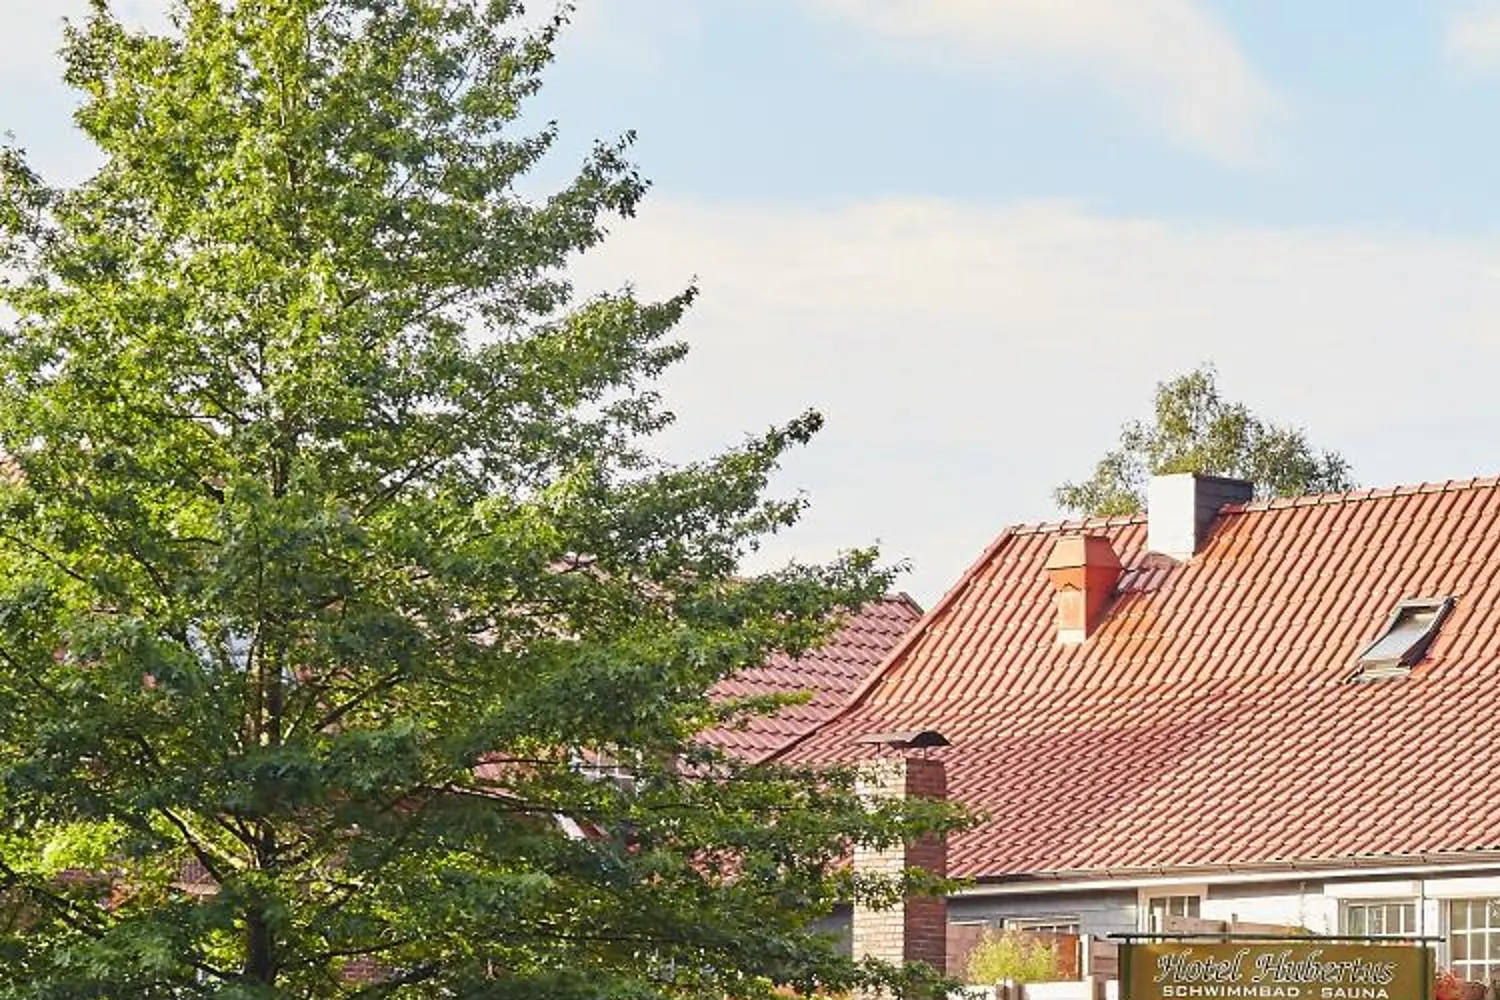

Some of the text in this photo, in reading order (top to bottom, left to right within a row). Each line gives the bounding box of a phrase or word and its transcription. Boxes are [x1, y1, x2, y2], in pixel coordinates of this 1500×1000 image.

[1153, 948, 1399, 985] Hotel Hubertus
[1162, 985, 1390, 1000] SCHWIMMBAD SAUNA
